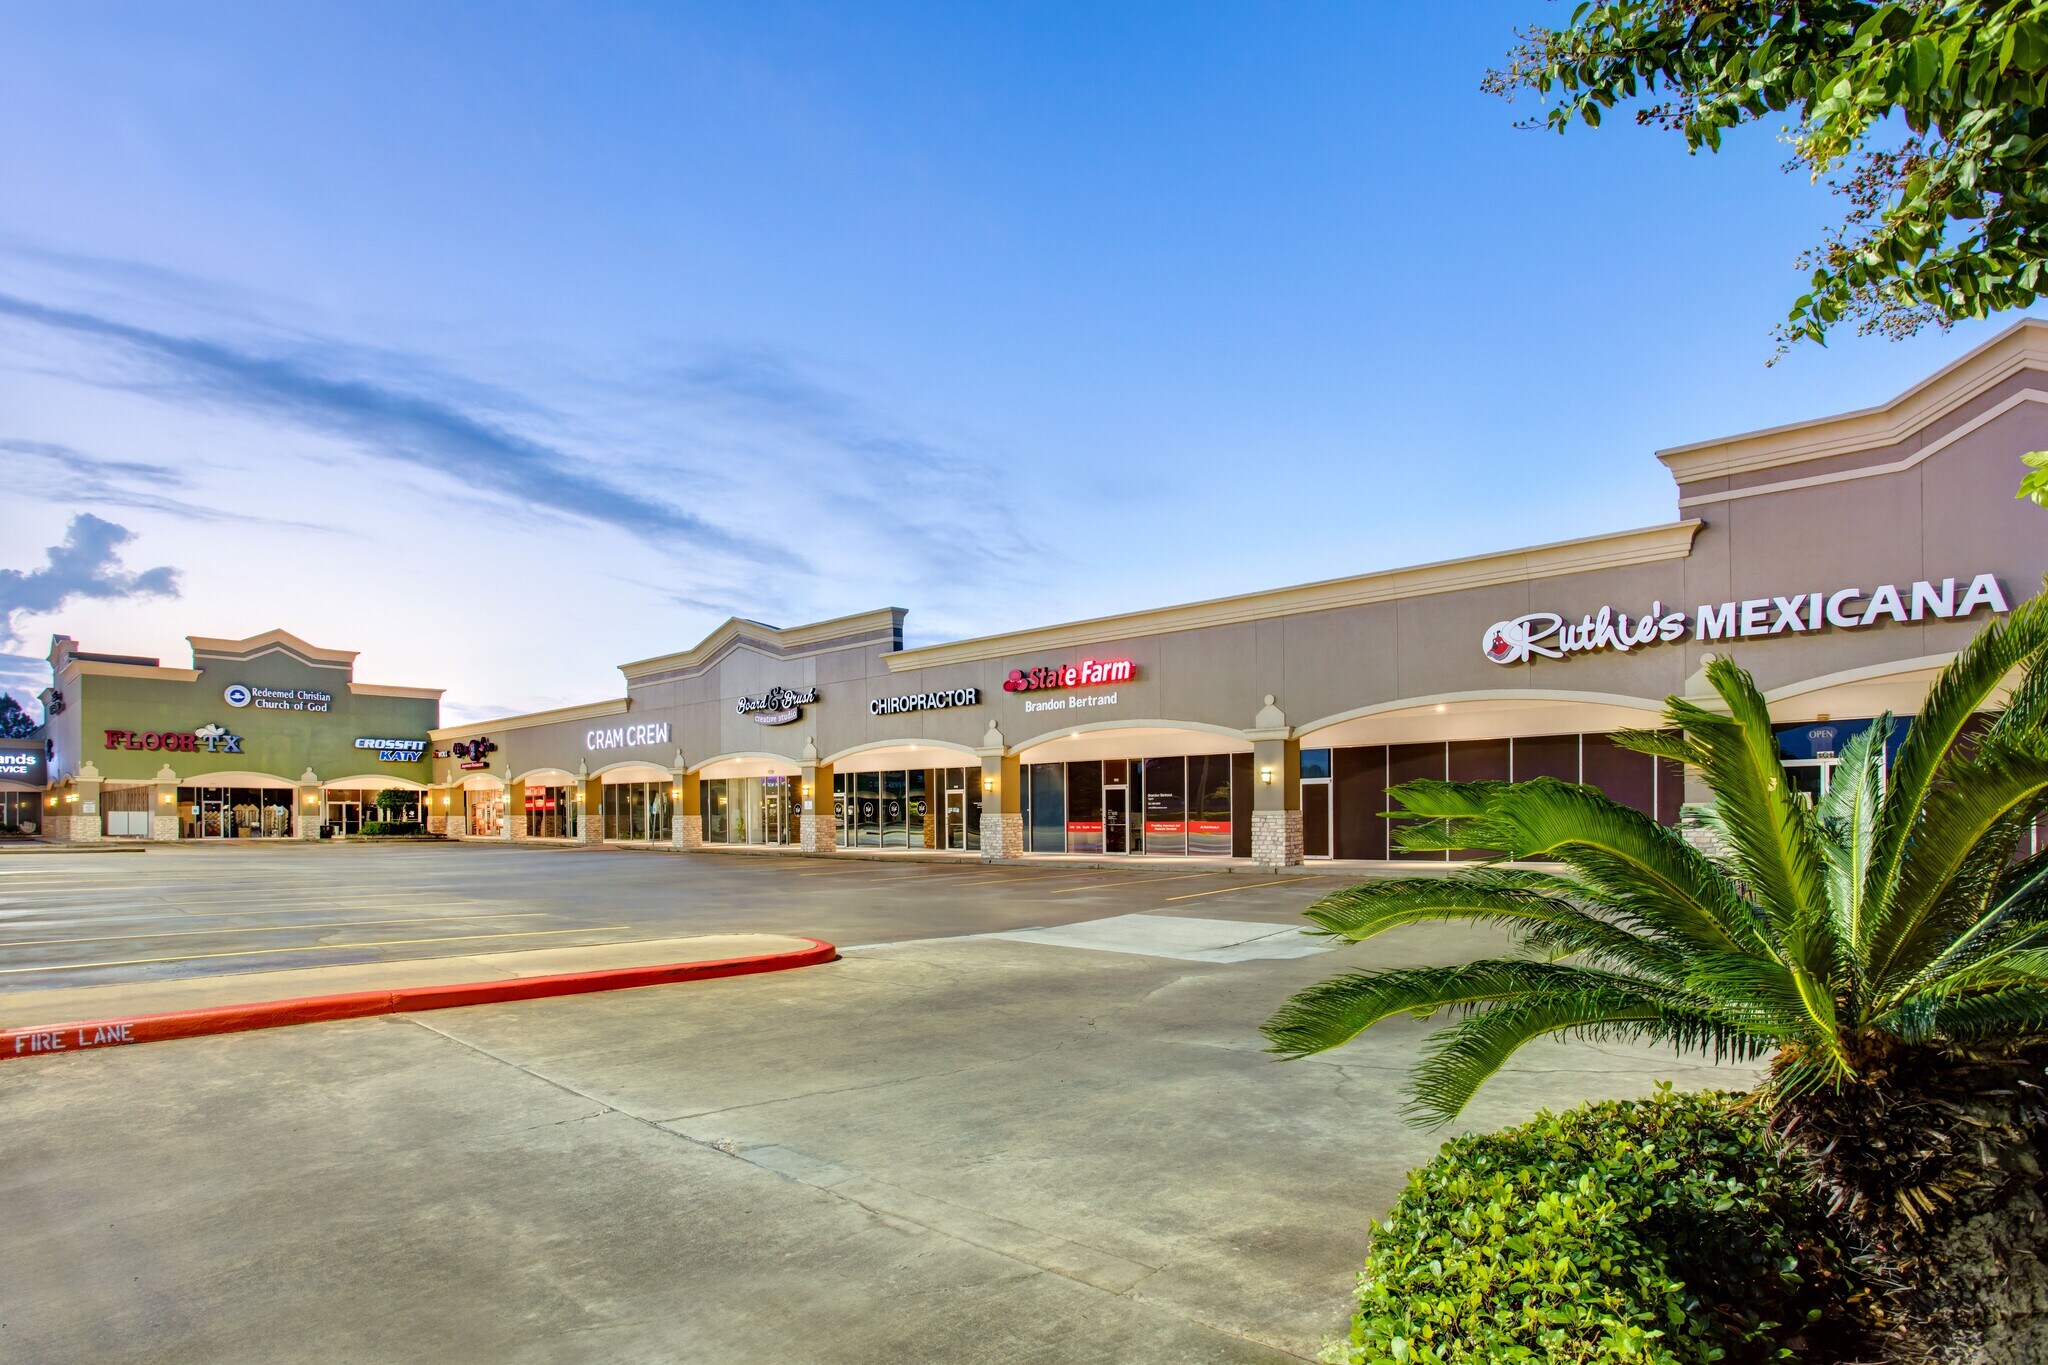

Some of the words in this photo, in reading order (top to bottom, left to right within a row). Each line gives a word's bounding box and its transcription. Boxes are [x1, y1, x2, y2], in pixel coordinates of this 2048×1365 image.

[1501, 600, 1686, 663] Ruthie's
[1695, 573, 2009, 641] MEXICANA
[1028, 665, 1077, 690] State
[1081, 660, 1131, 684] Farm
[252, 687, 294, 699] Redeemed
[297, 690, 331, 702] Christian
[255, 698, 289, 710] Church
[294, 702, 304, 711] of
[308, 702, 327, 712] God
[736, 695, 768, 714] Board
[768, 687, 784, 712] &
[781, 688, 815, 709] Brush
[870, 688, 977, 715] CHIROPRACTOR
[1025, 698, 1065, 713] Brandon
[1069, 692, 1117, 709] Bertrand
[754, 714, 777, 723] creative
[778, 711, 797, 722] studio
[104, 730, 198, 752] FLOOR
[203, 734, 241, 753] TX
[354, 738, 427, 751] CROSSFIT
[587, 728, 623, 750] CRAM
[627, 722, 668, 747] CREW
[1809, 730, 1833, 739] OPEN
[379, 750, 422, 762] KATY
[15, 1031, 66, 1053] FIRE
[78, 1023, 135, 1047] LANE
